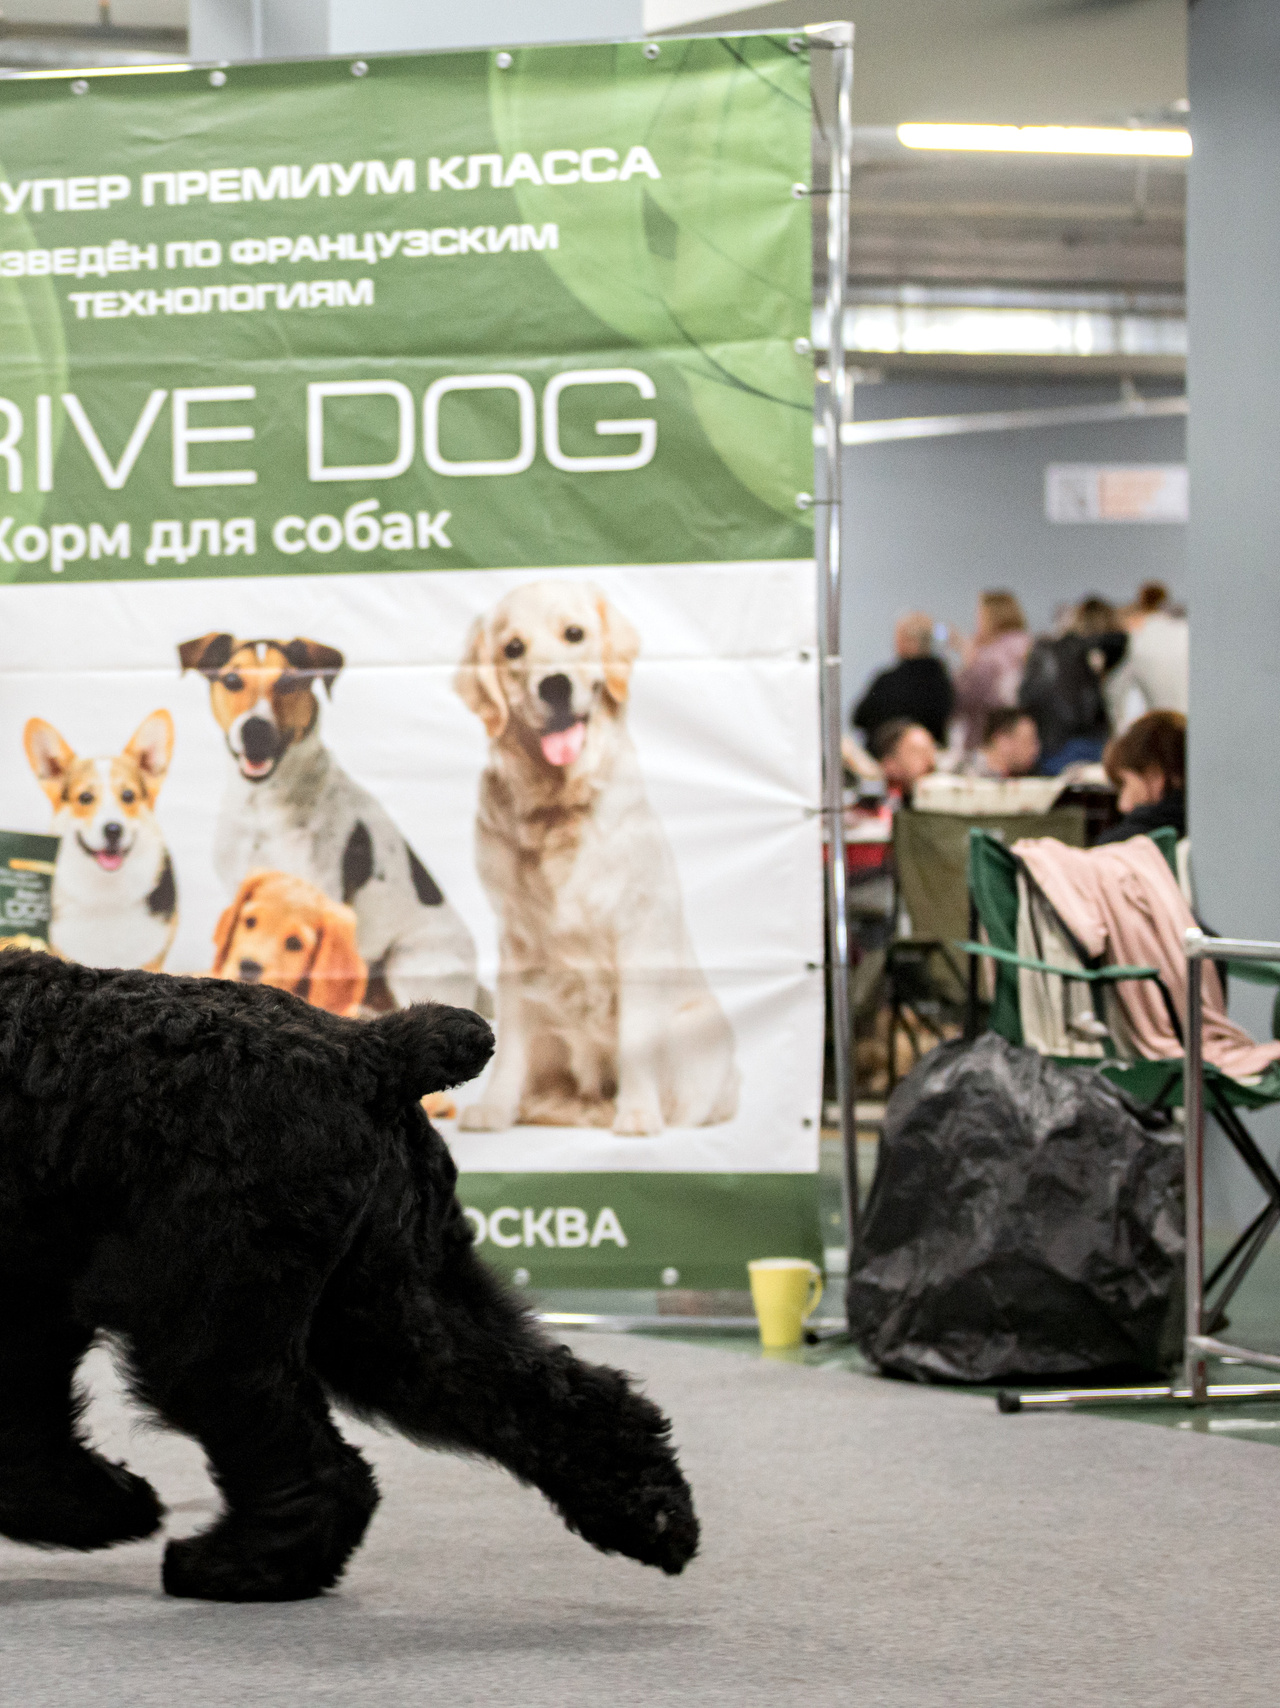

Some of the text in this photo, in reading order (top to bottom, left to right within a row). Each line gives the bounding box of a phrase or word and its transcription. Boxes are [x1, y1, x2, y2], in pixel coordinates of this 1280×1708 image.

[142, 158, 415, 207] ПРЕМИУМ
[429, 146, 661, 192] КЛАССА
[166, 240, 221, 269] ПО
[230, 223, 558, 264] ФРАНЦУЗСКИМ
[69, 278, 374, 319] ТЕХНОЛОГИЯМ
[307, 368, 657, 482] DOG
[146, 518, 257, 565] для
[272, 499, 452, 555] собак
[461, 1207, 629, 1248] ОСКВА
